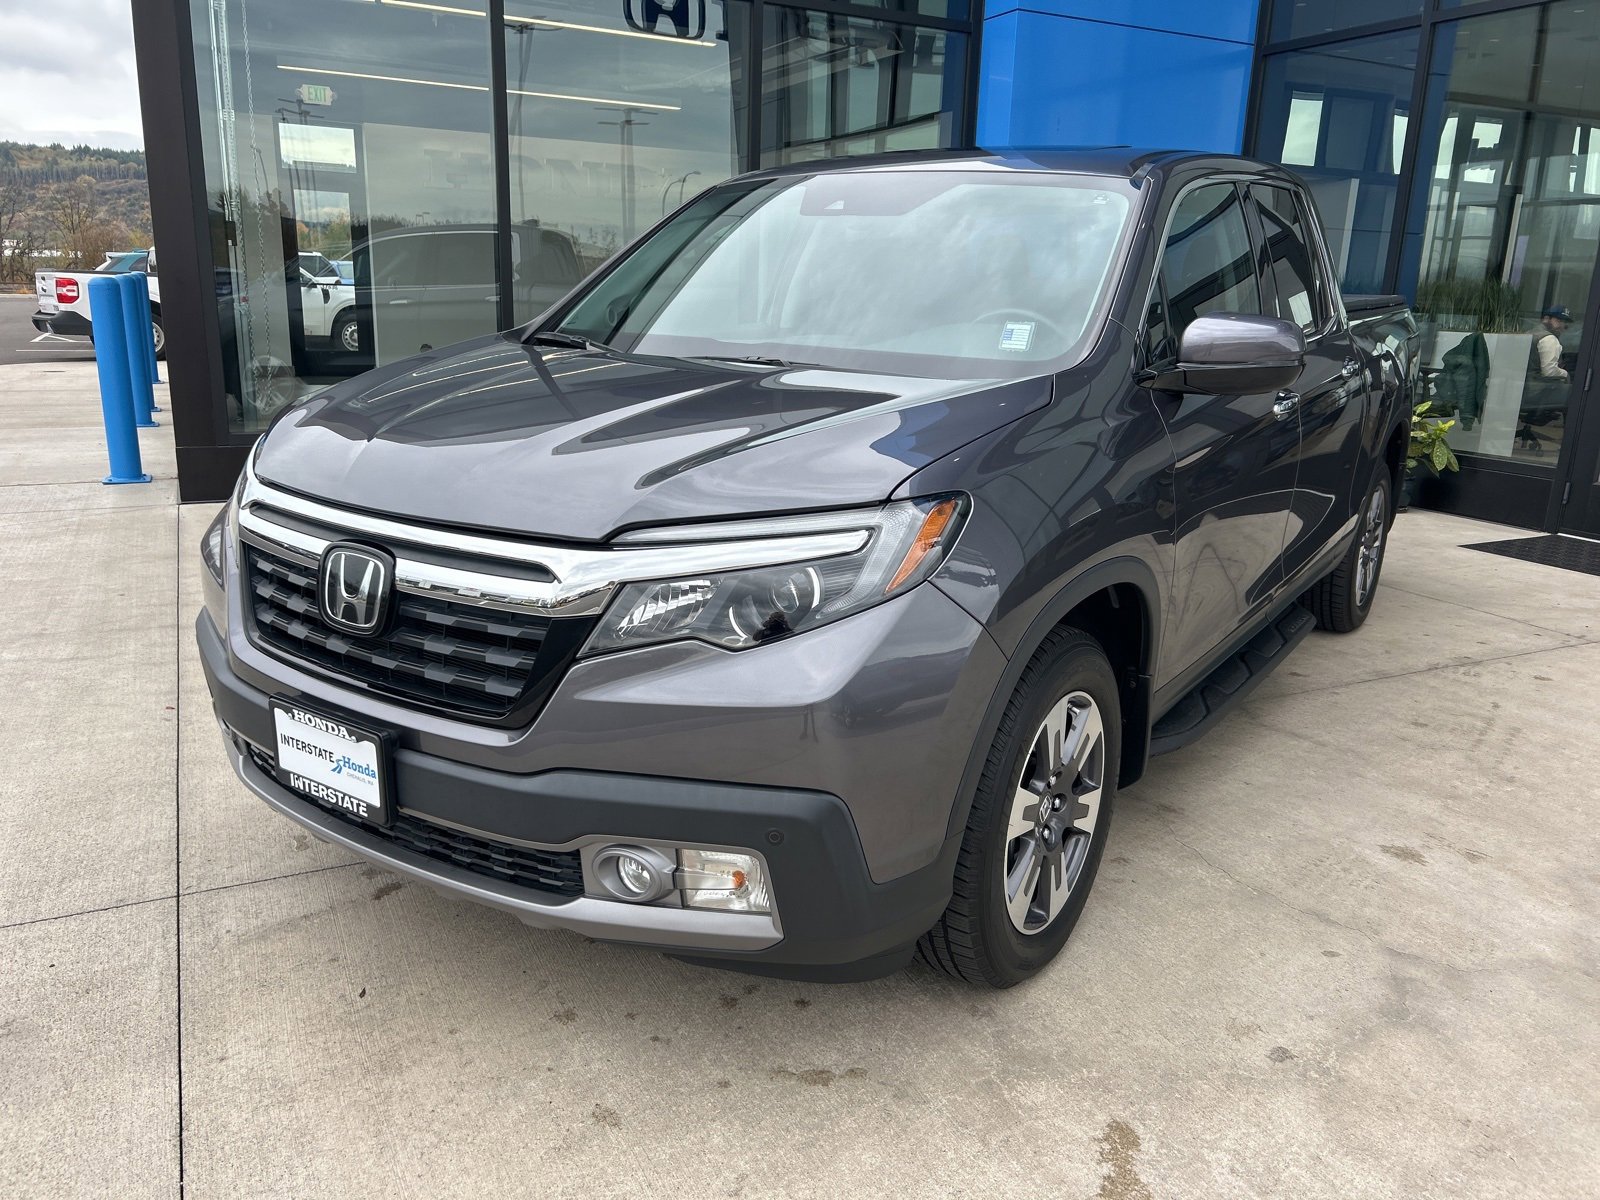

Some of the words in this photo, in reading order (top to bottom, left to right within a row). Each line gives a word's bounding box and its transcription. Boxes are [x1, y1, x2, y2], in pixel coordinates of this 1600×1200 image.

[307, 86, 327, 103] EXIT
[292, 708, 351, 740] HONDA
[280, 732, 335, 763] INTERSTATE
[341, 755, 377, 780] Honda
[289, 773, 369, 818] INTERSTATE
